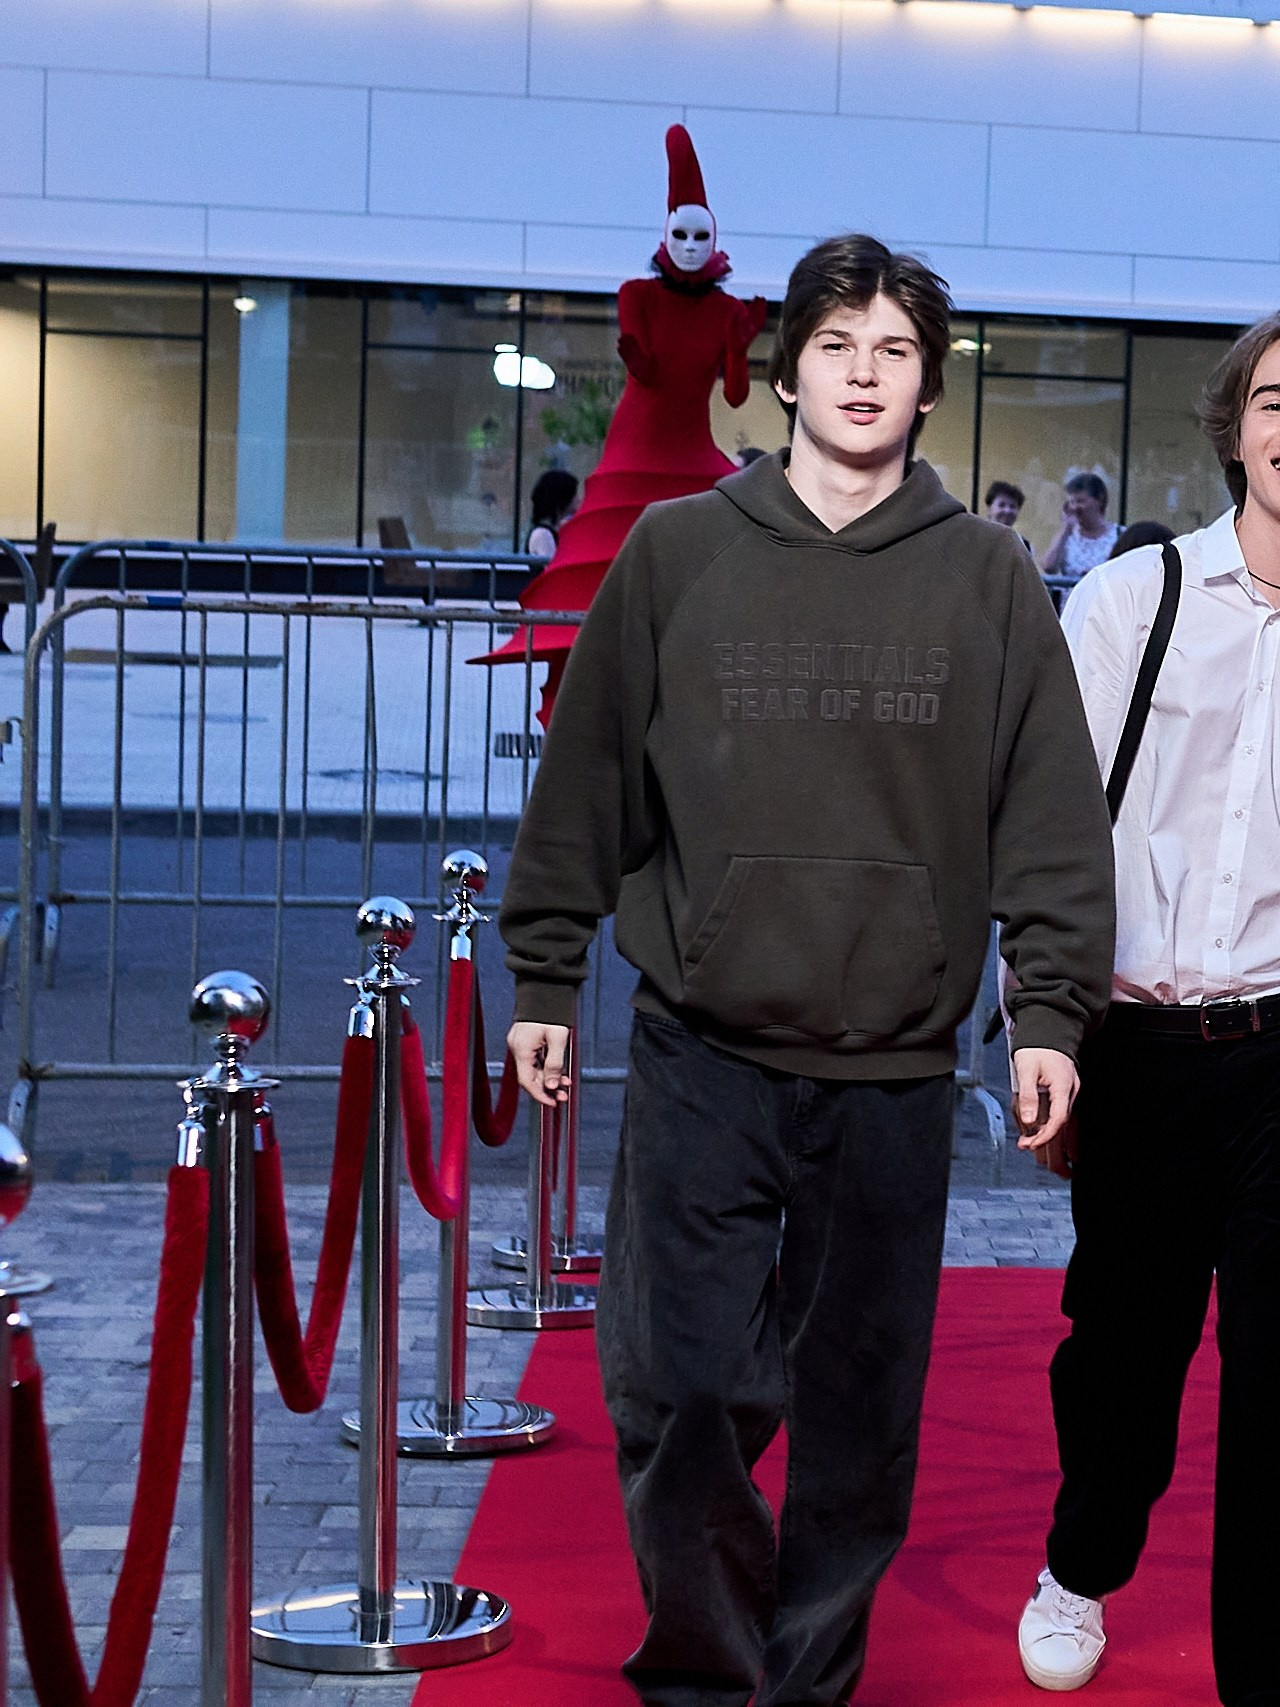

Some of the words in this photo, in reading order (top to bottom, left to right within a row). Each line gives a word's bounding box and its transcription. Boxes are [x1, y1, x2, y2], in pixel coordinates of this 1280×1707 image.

[713, 642, 950, 685] ESSENTIALS
[721, 687, 809, 721] FEAR
[820, 688, 861, 721] OF
[873, 690, 940, 725] GOD
